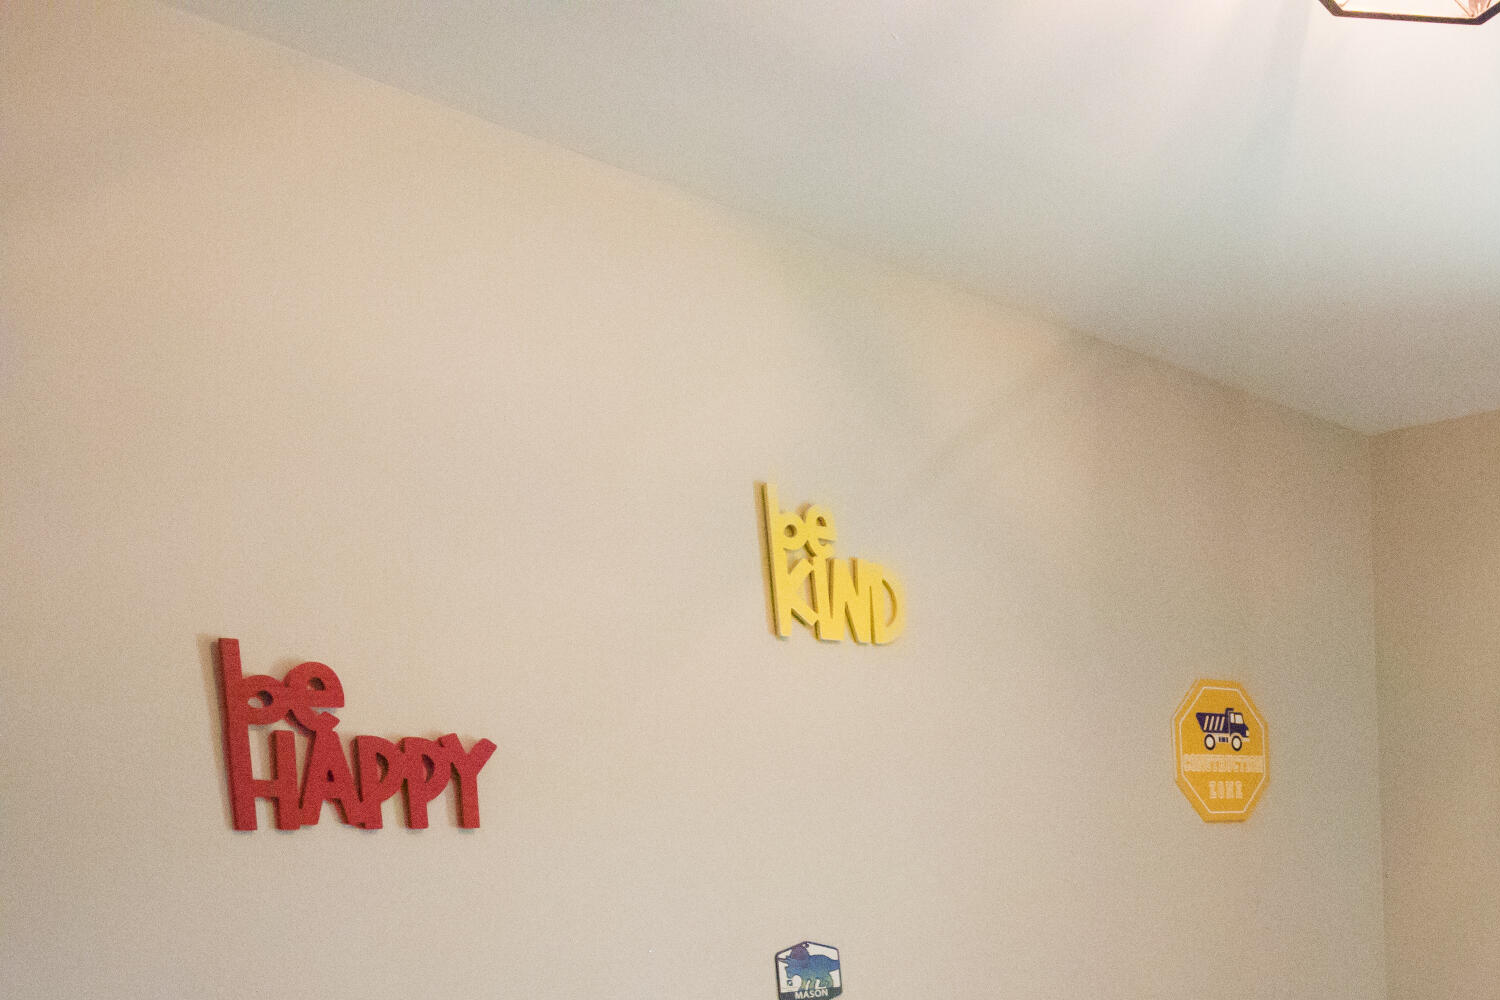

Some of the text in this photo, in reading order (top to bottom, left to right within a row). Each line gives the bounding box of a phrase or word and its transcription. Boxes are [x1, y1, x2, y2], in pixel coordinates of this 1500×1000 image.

[218, 637, 345, 730] be
[228, 728, 497, 830] HAPPY
[1208, 780, 1244, 799] ZONE
[794, 988, 829, 1000] MASON
